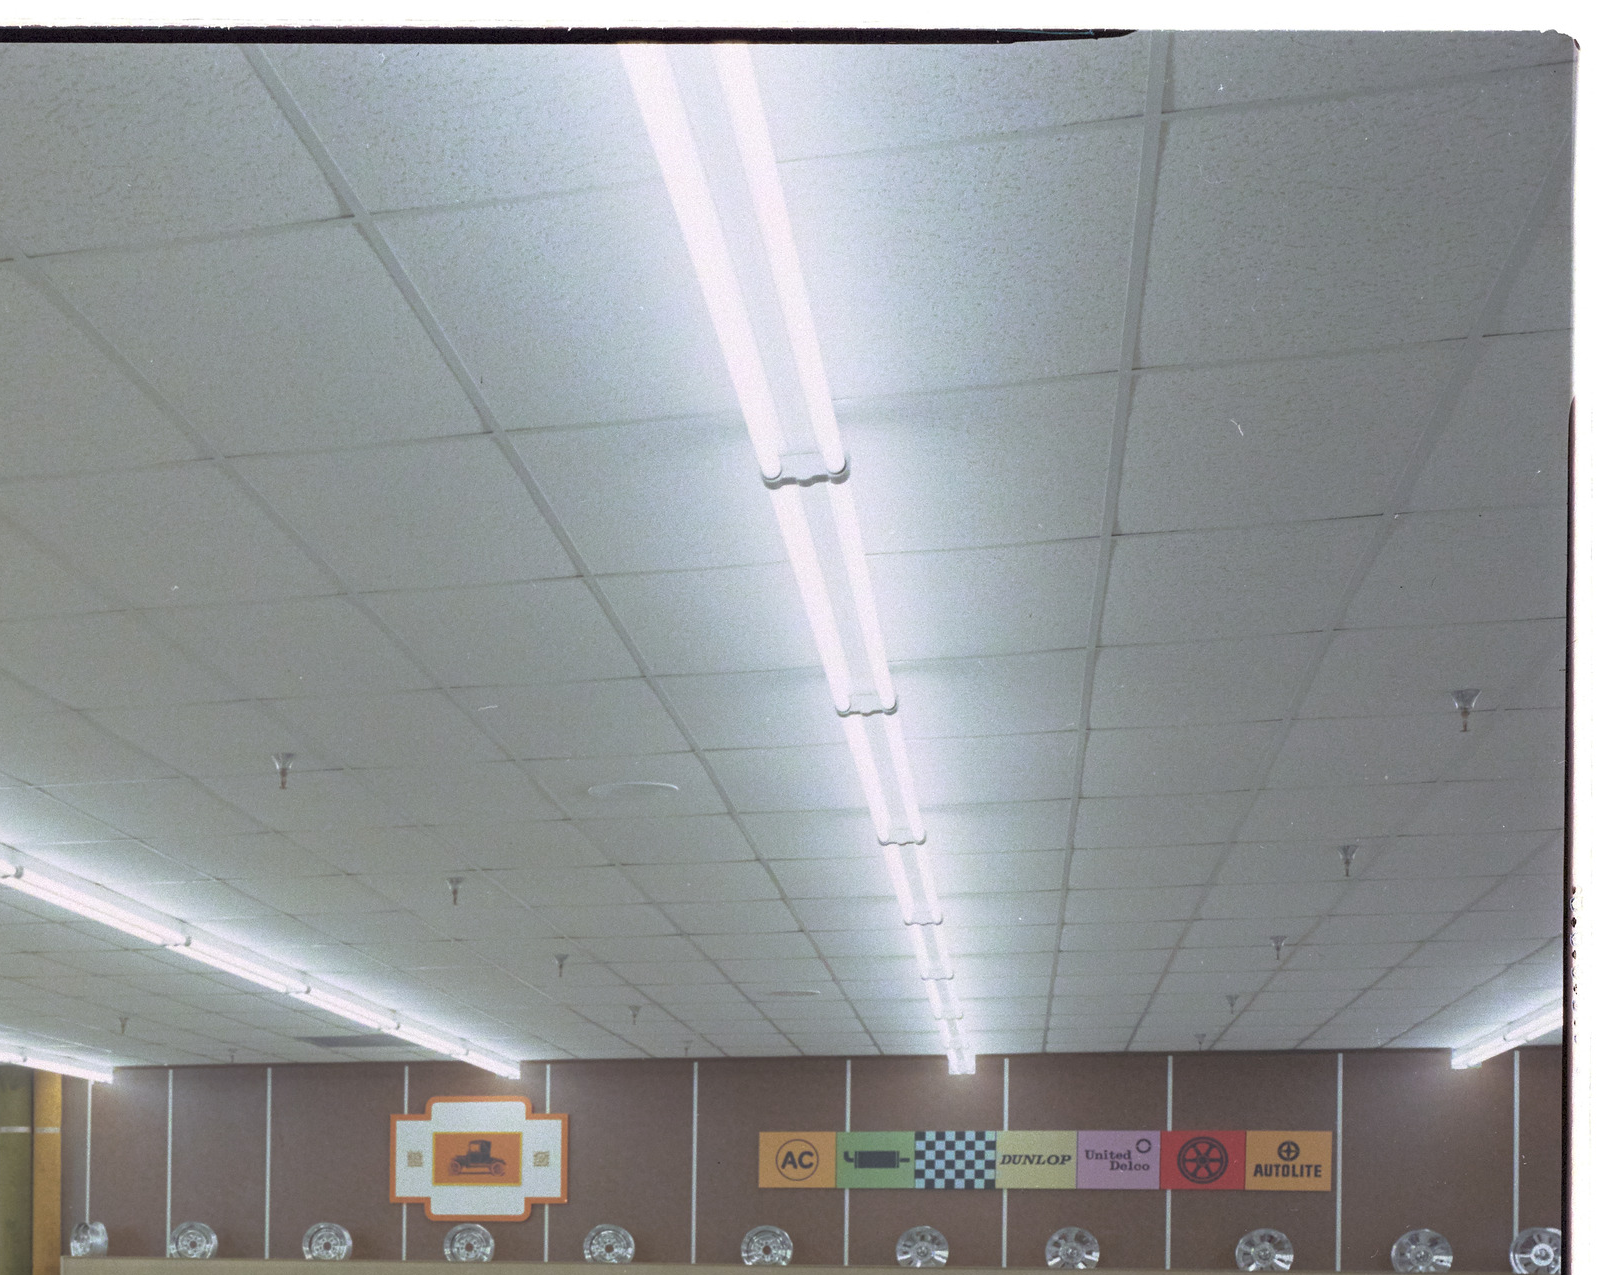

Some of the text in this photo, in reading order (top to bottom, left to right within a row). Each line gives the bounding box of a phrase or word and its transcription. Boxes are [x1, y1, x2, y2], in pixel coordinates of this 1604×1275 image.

[781, 1151, 814, 1169] AC
[1000, 1154, 1071, 1165] DUNLOP
[1084, 1149, 1132, 1161] United
[1109, 1159, 1150, 1171] Delco
[1253, 1163, 1322, 1178] AUTOLITE
